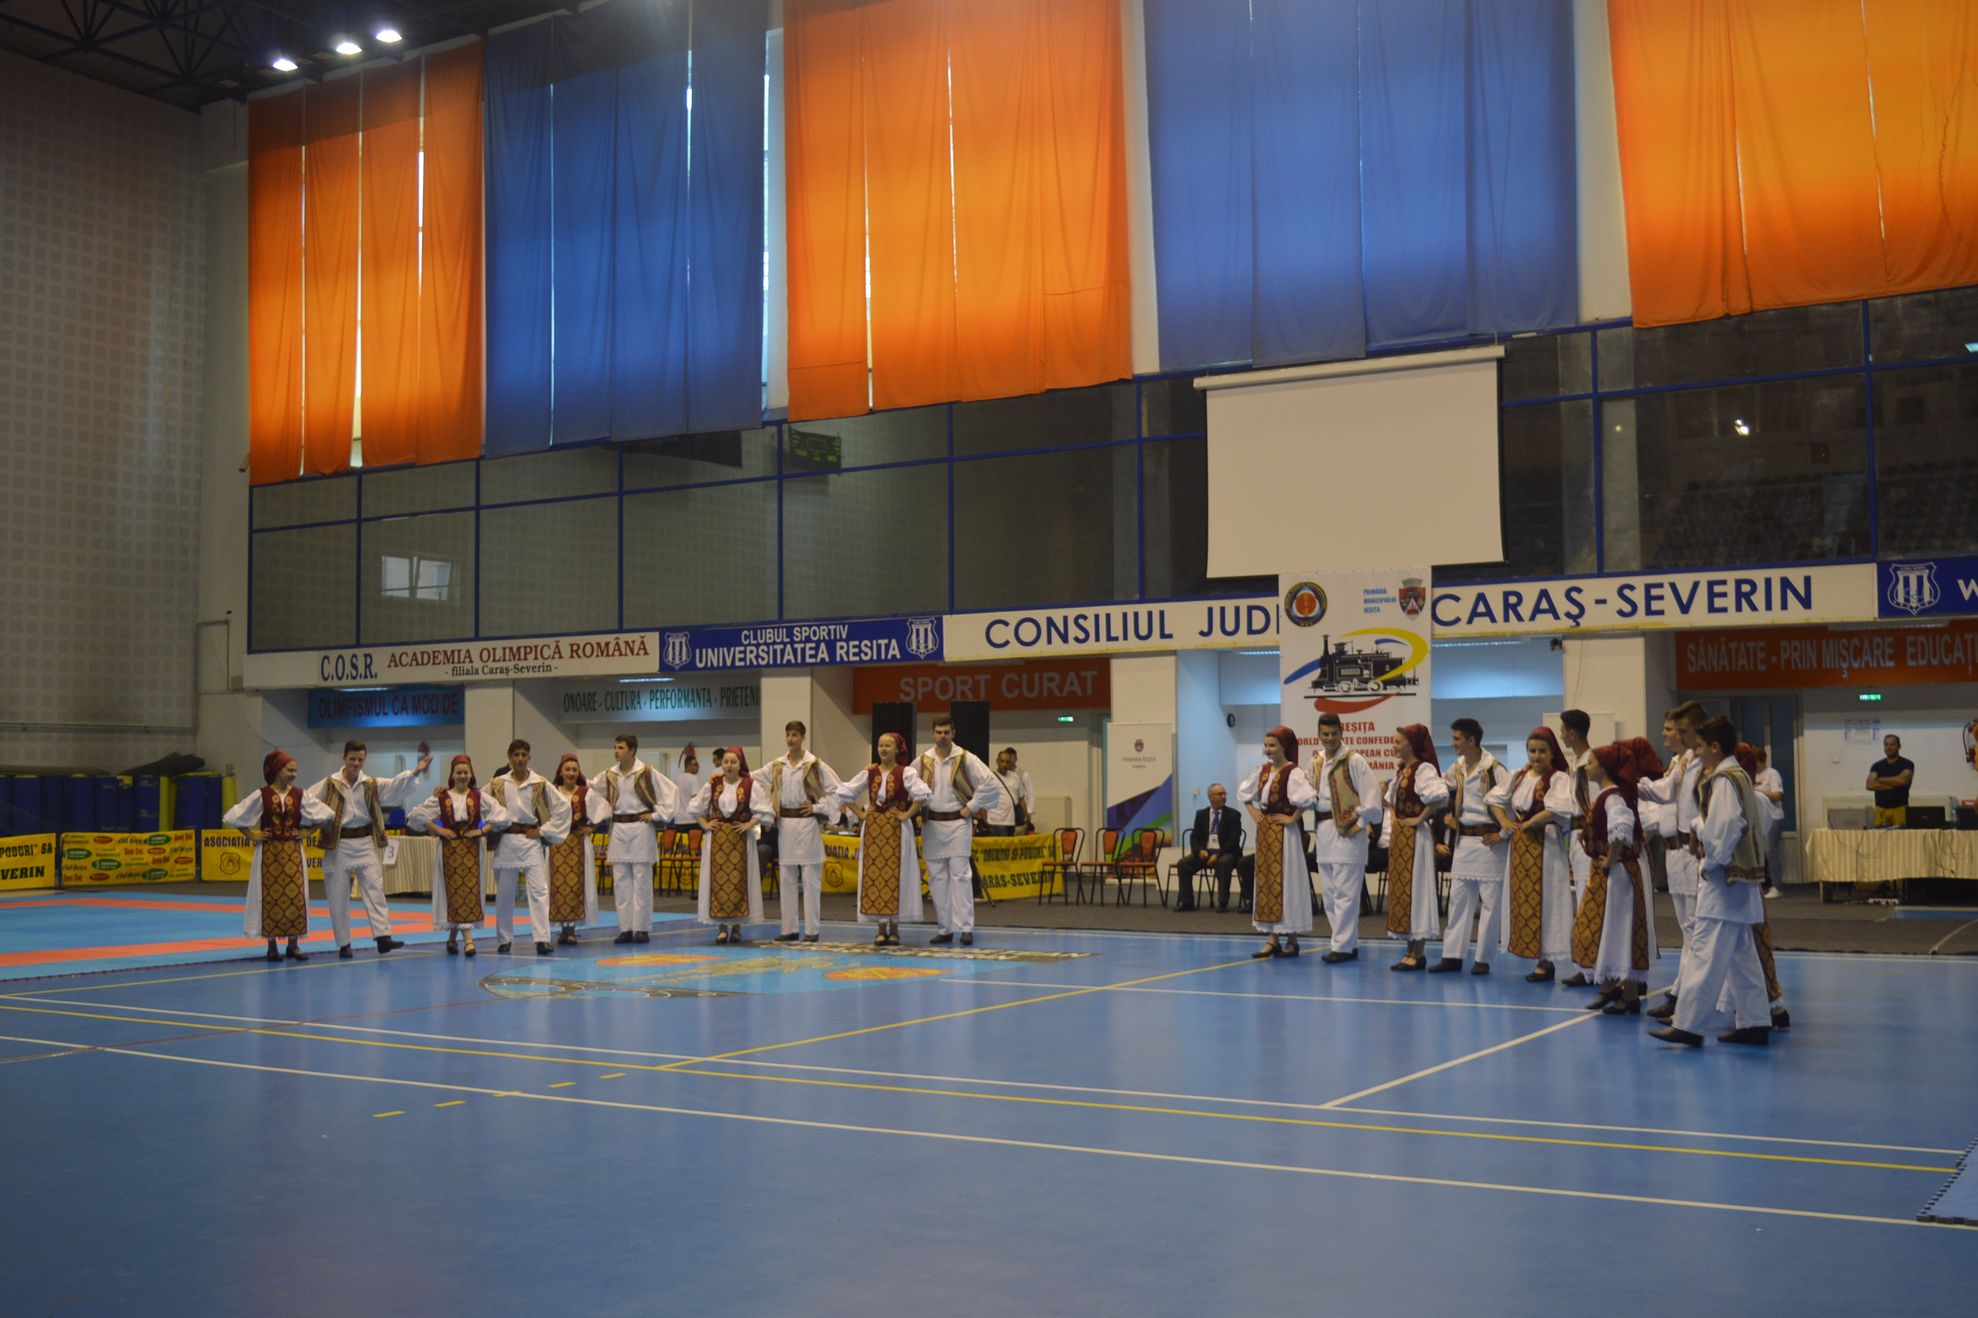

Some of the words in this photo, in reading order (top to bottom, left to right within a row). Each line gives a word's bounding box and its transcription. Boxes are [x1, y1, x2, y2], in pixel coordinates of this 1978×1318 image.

[741, 627, 789, 645] CLUBUL
[793, 624, 849, 642] SPORTIV
[985, 609, 1174, 649] CONSILIUL
[387, 648, 474, 669] ACADEMIA
[479, 640, 564, 664] OLIMPICĂ
[569, 635, 650, 660] ROMÂNĂ
[695, 641, 830, 668] UNIVERSITATEA
[836, 638, 901, 662] RESITA
[1780, 639, 1817, 671] PRIN
[320, 652, 378, 682] C.O.S.R.
[451, 665, 480, 677] filiala
[900, 674, 991, 701] SPORT
[1002, 670, 1098, 699] CURAT
[318, 693, 389, 719] OLIMPISMUL
[391, 695, 409, 716] CA
[412, 693, 440, 715] MOD
[442, 692, 459, 714] DE
[563, 691, 598, 713] ONOARE
[604, 689, 642, 712] CULTURA
[649, 687, 713, 710] PERFORMANTA
[1297, 737, 1319, 745] ORLD
[1356, 735, 1396, 745] CONFEDE
[41, 842, 53, 855] SA
[387, 845, 395, 859] 3
[1, 865, 45, 880] VERIN
